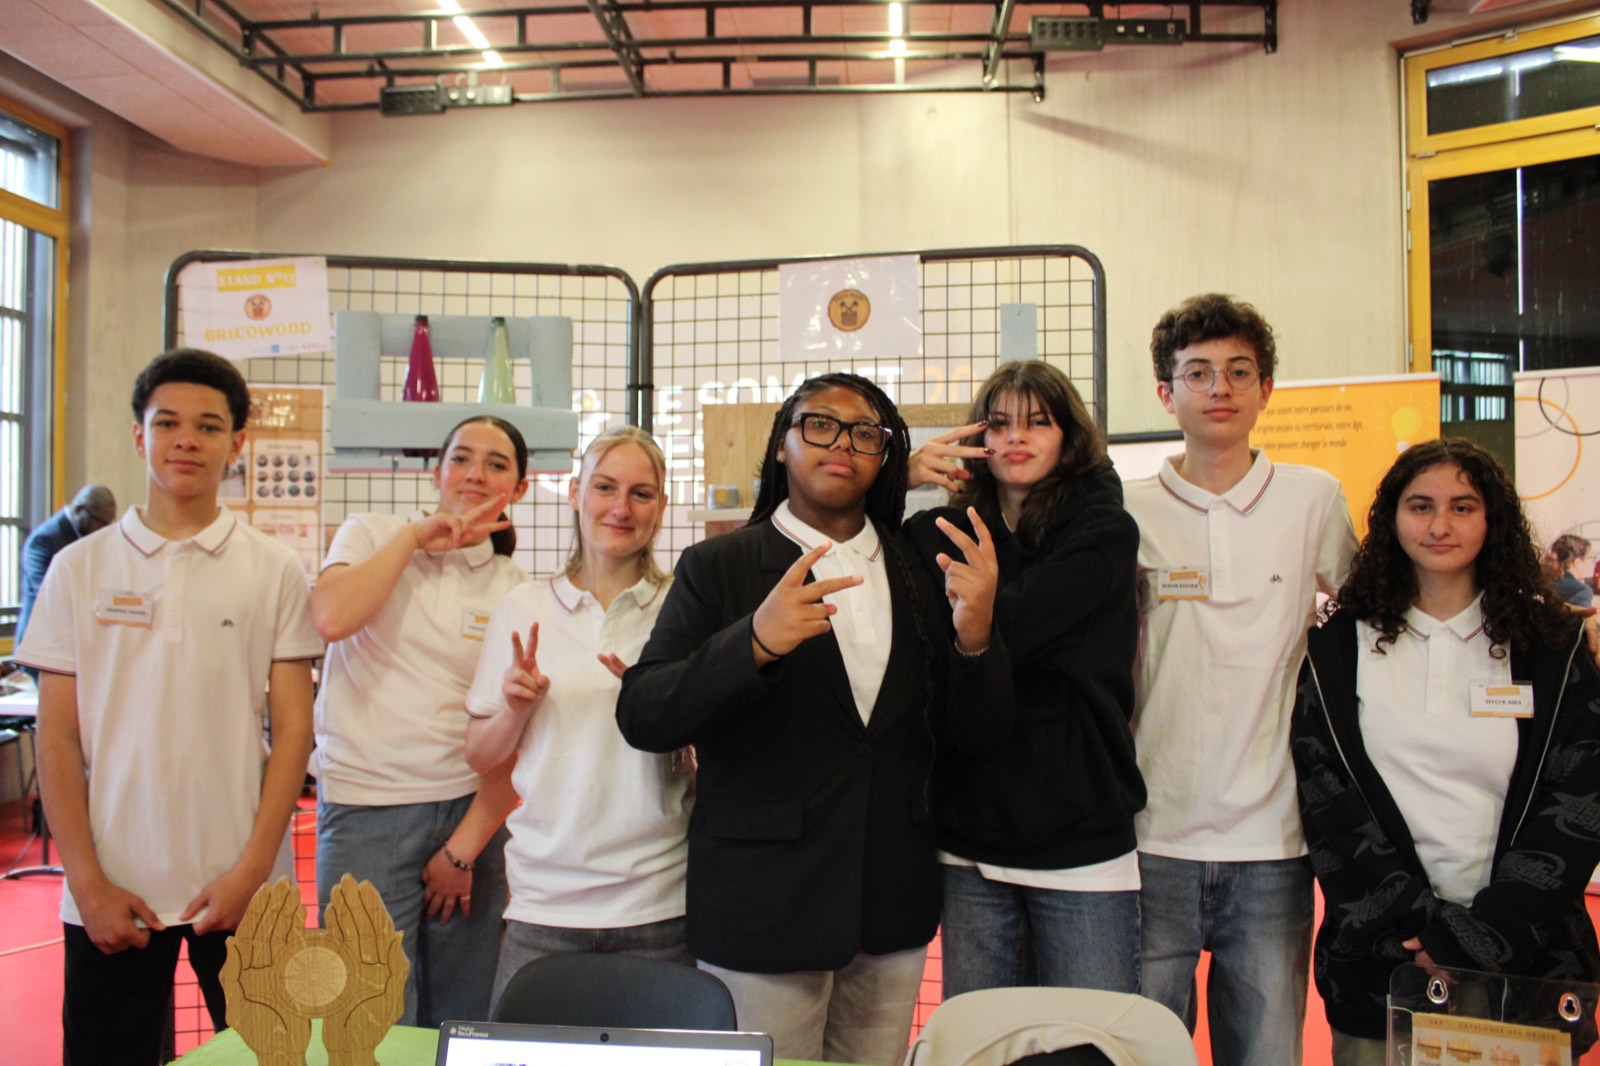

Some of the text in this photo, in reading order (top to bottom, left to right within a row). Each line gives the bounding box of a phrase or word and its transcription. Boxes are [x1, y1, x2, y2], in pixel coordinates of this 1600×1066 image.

[217, 273, 262, 288] STAND
[204, 321, 312, 342] BRICOWOOD
[1459, 1022, 1505, 1034] CATALOGUE
[1525, 1032, 1557, 1041] OBJETS
